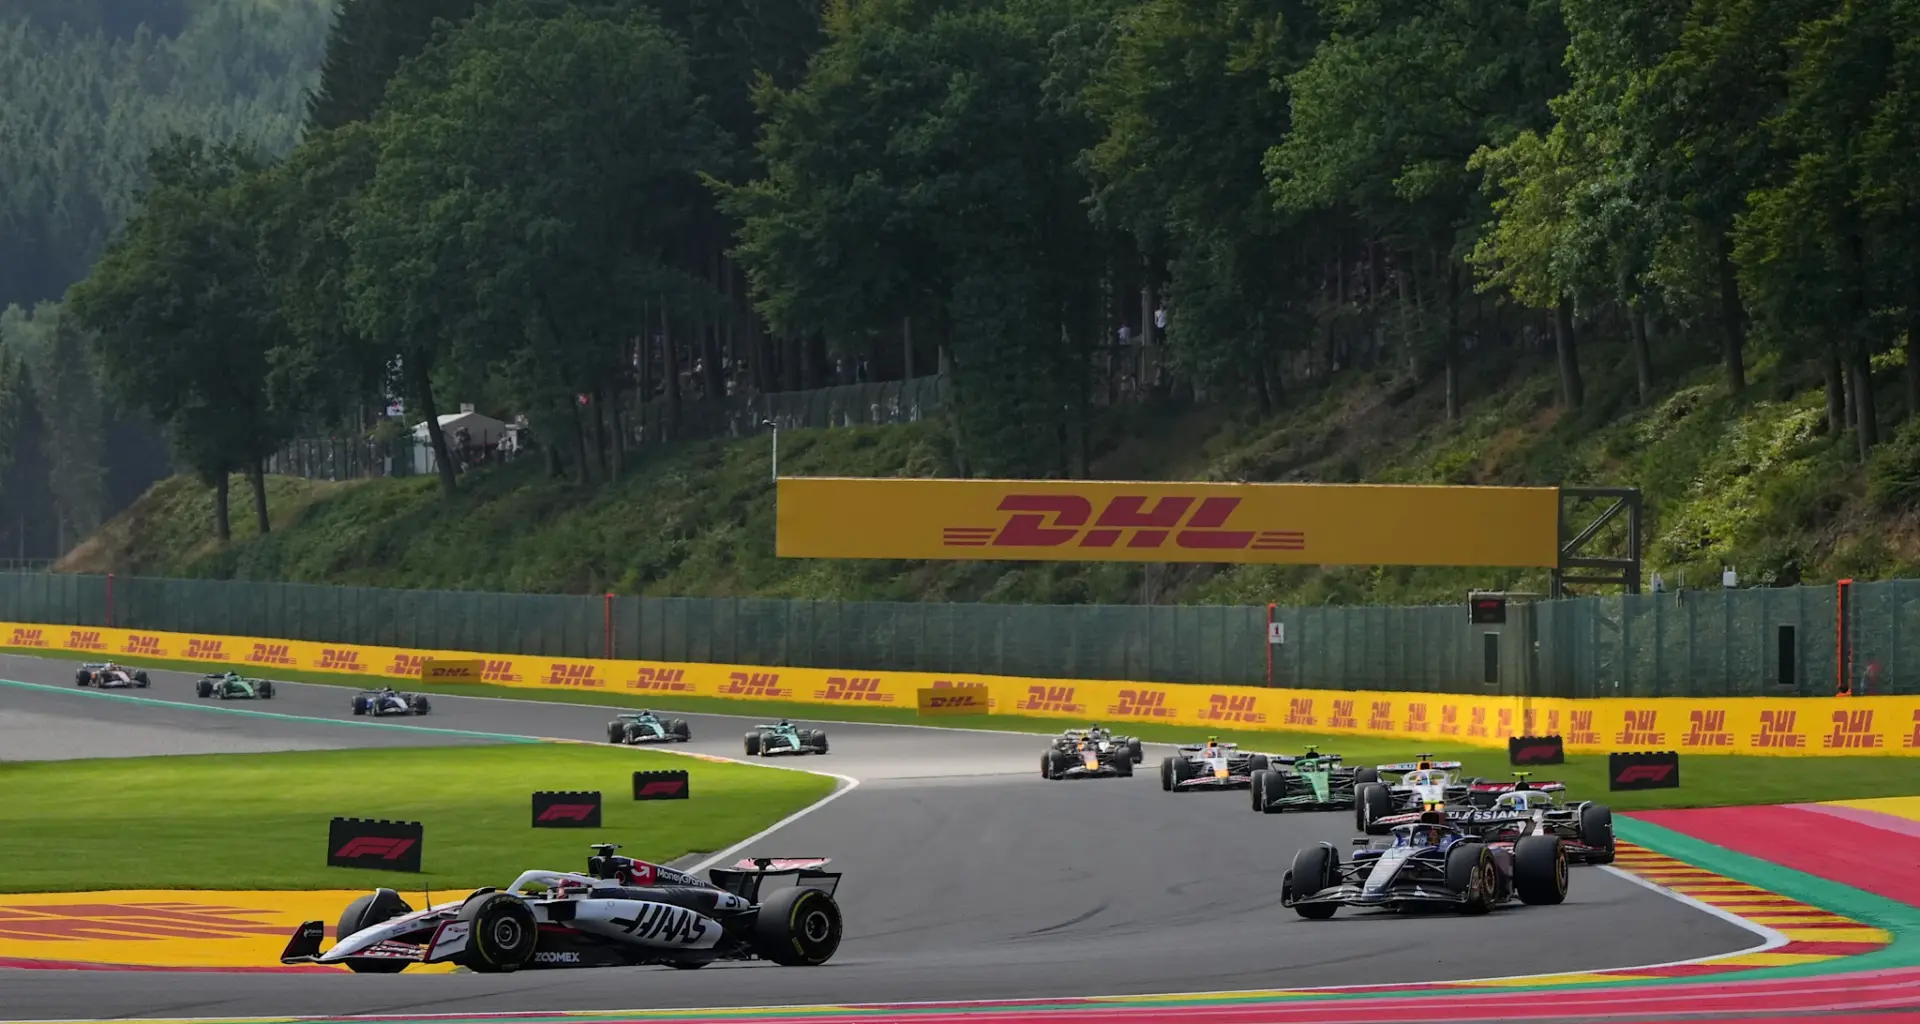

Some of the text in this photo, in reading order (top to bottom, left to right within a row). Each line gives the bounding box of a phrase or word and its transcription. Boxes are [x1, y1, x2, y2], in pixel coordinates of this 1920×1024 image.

[991, 494, 1256, 549] DHL
[11, 629, 43, 646] DHL
[68, 631, 103, 649] DHL
[127, 635, 162, 655] DHL
[188, 639, 225, 659] DHL
[251, 643, 291, 664] DHL
[320, 649, 361, 671] DHL
[550, 664, 597, 687] DHL
[636, 668, 687, 691] DHL
[727, 672, 782, 697] DHL
[825, 677, 883, 702] DHL
[1026, 686, 1079, 713] DHL
[930, 696, 977, 707] DHL
[1117, 690, 1168, 718] DHL
[1208, 694, 1258, 723] DHL
[1622, 710, 1658, 745] DHL
[1688, 710, 1728, 747] DHL
[1757, 710, 1801, 748] DHL
[1831, 710, 1875, 748] DHL
[1446, 810, 1519, 821] TLASSIAN
[334, 837, 417, 860] F1
[656, 867, 705, 888] MoneyGram
[610, 903, 707, 944] HAAS
[534, 951, 581, 963] ZOOMEX
